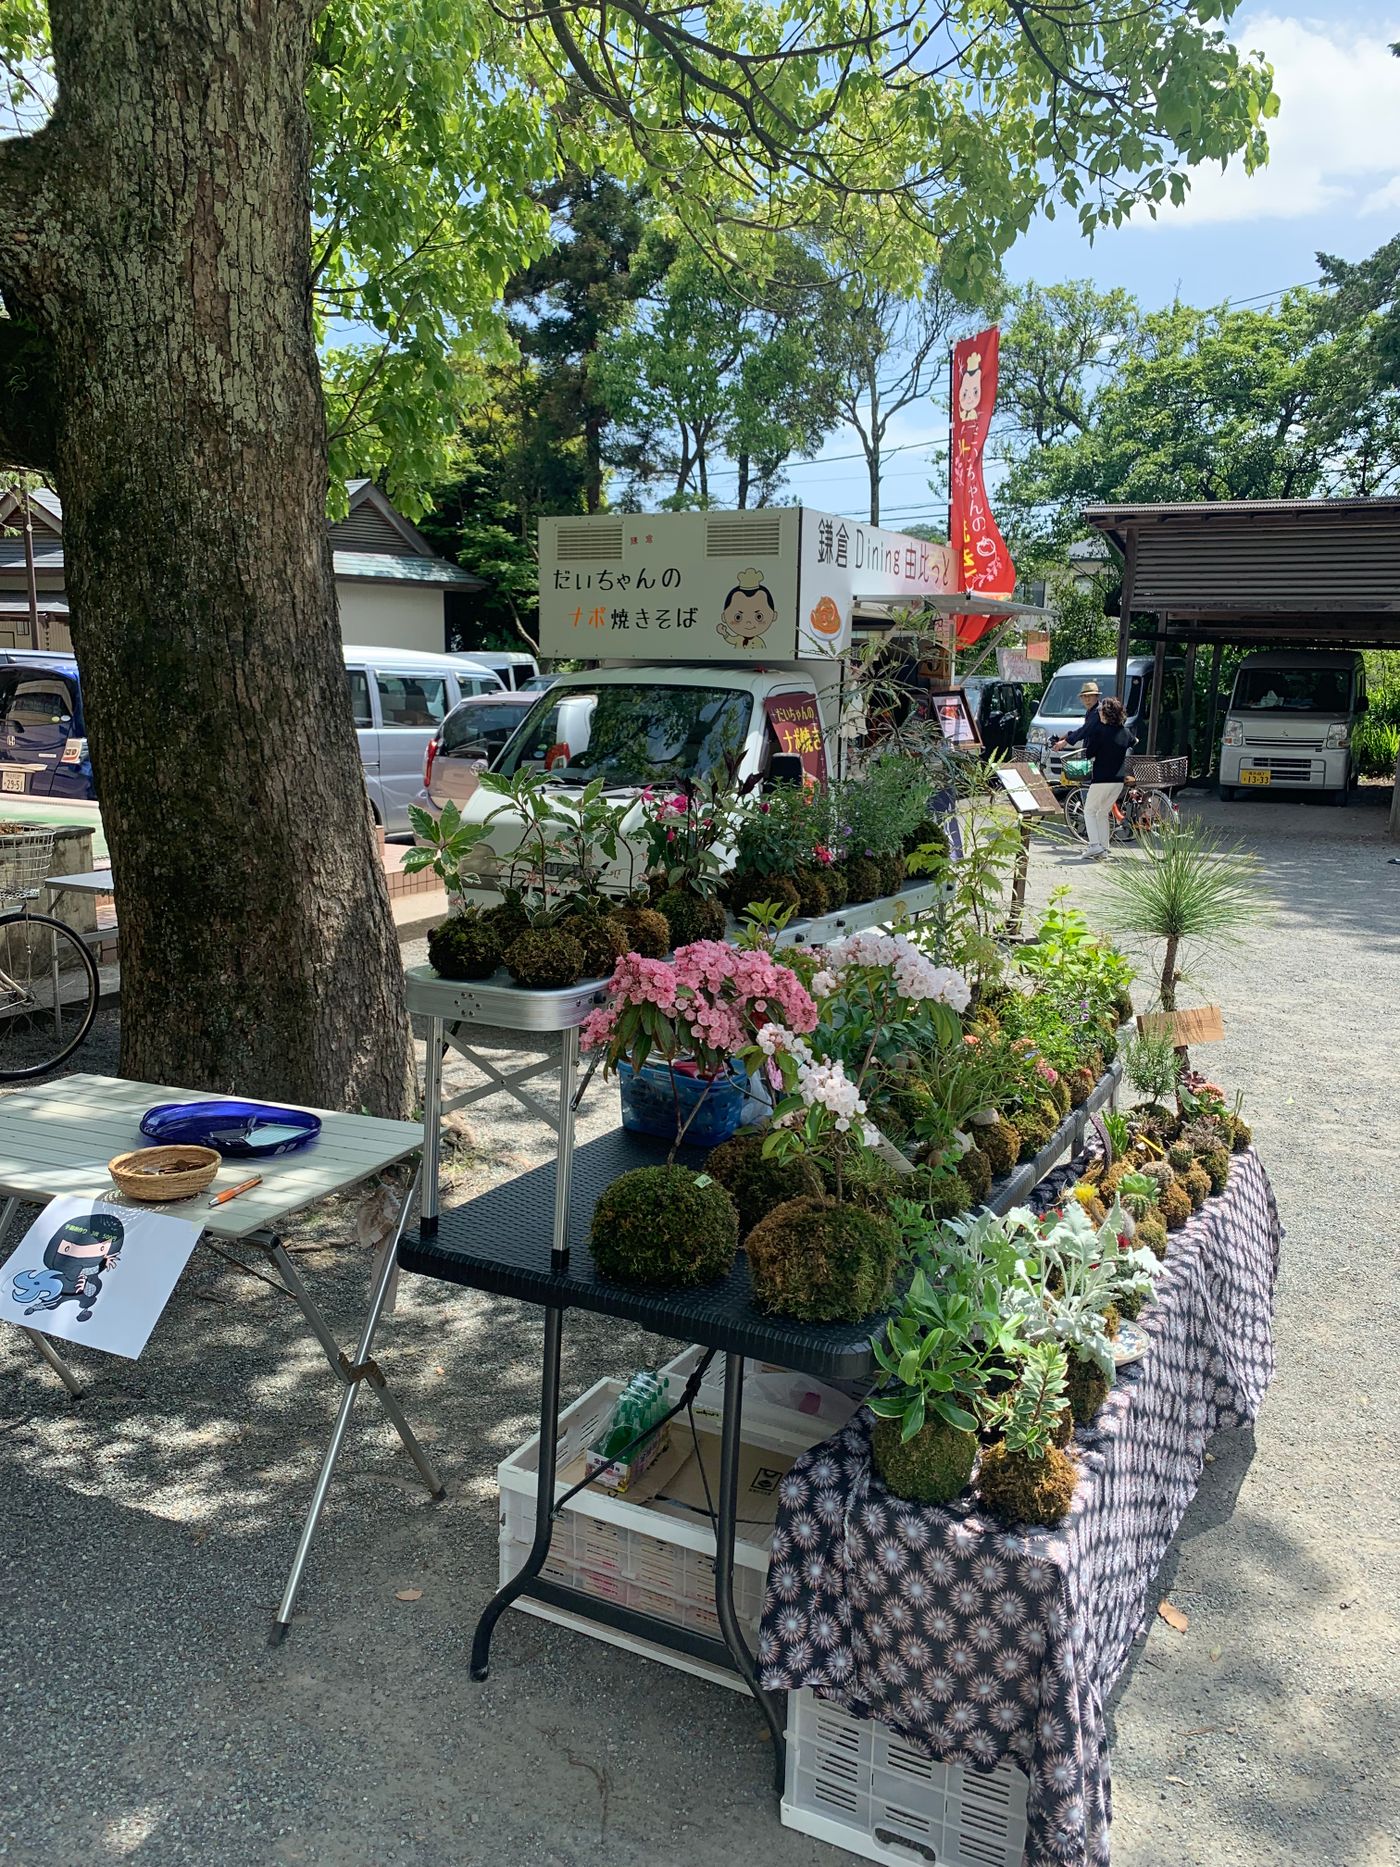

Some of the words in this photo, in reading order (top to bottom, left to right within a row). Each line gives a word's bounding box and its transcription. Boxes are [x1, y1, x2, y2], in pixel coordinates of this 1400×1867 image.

[817, 518, 850, 569] 鎌倉
[855, 528, 900, 575] Dining
[904, 542, 950, 586] 由比っと
[553, 567, 681, 591] だいちゃんの
[568, 606, 699, 630] ナポ焼きそば
[775, 705, 815, 722] だいちゃんの
